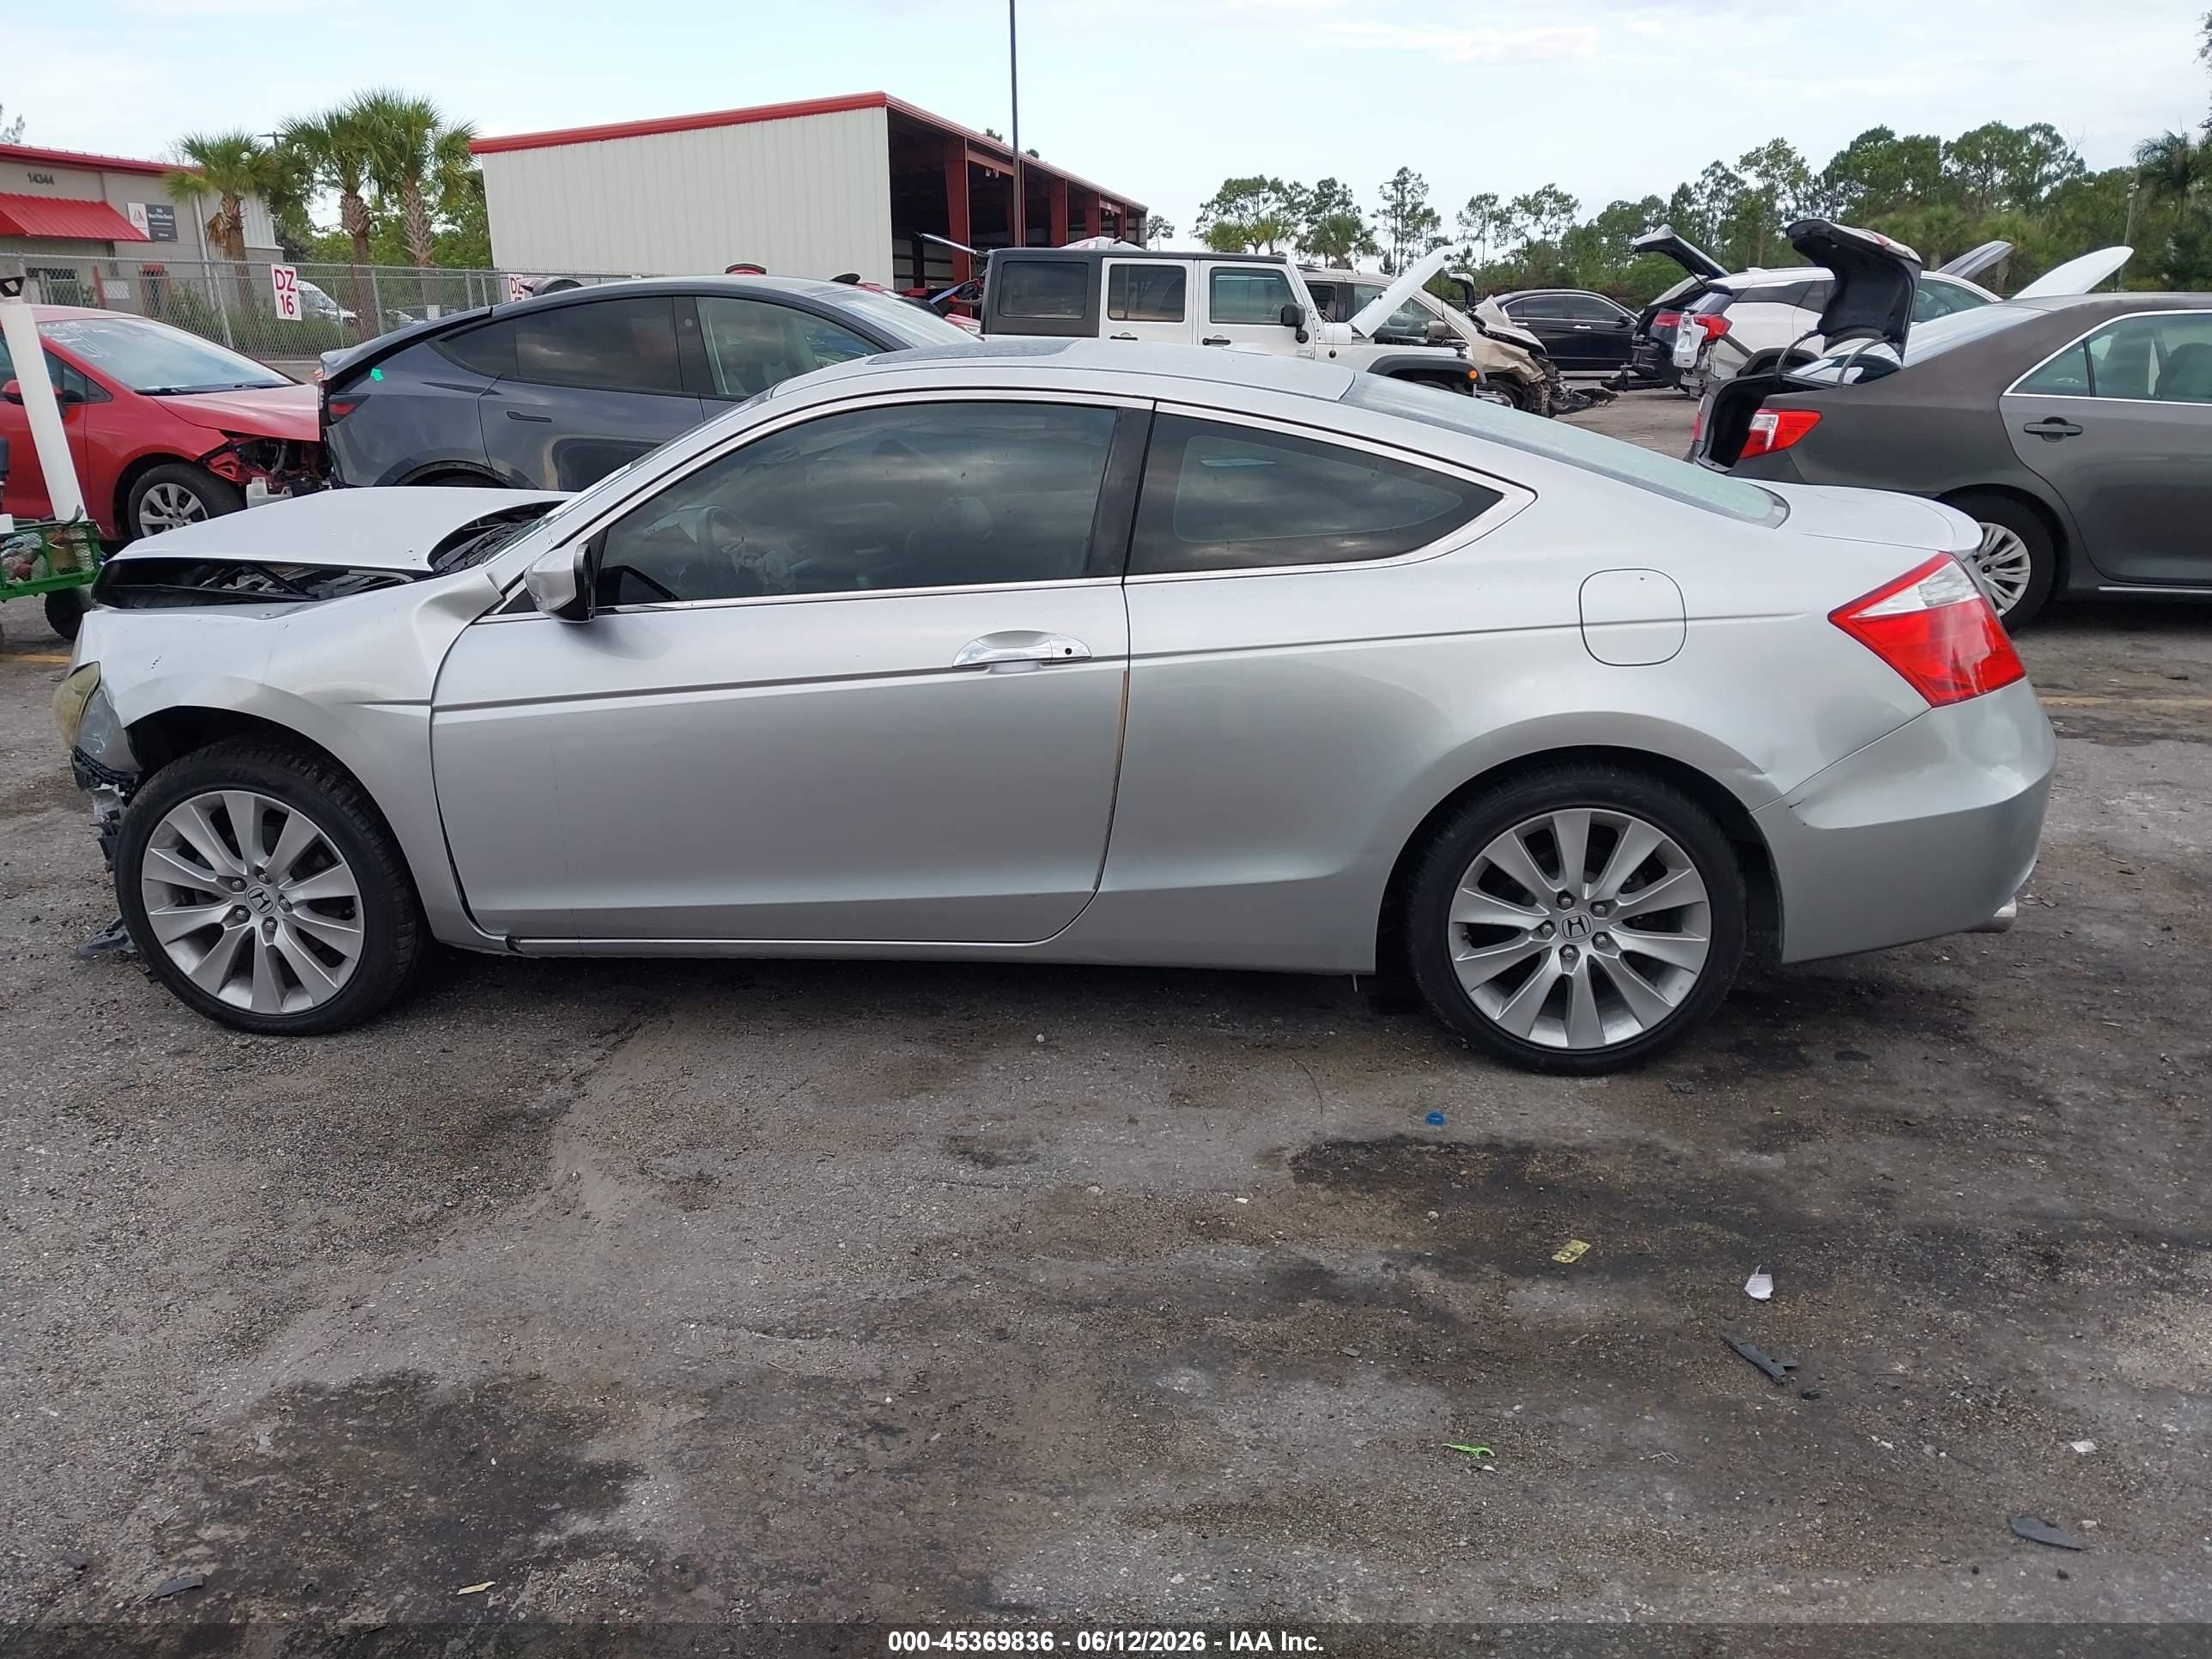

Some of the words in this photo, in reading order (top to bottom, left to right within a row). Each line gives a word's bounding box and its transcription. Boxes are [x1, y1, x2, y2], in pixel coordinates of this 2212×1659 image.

[27, 172, 54, 185] 14344
[274, 269, 296, 292] DZ
[280, 294, 295, 315] 16
